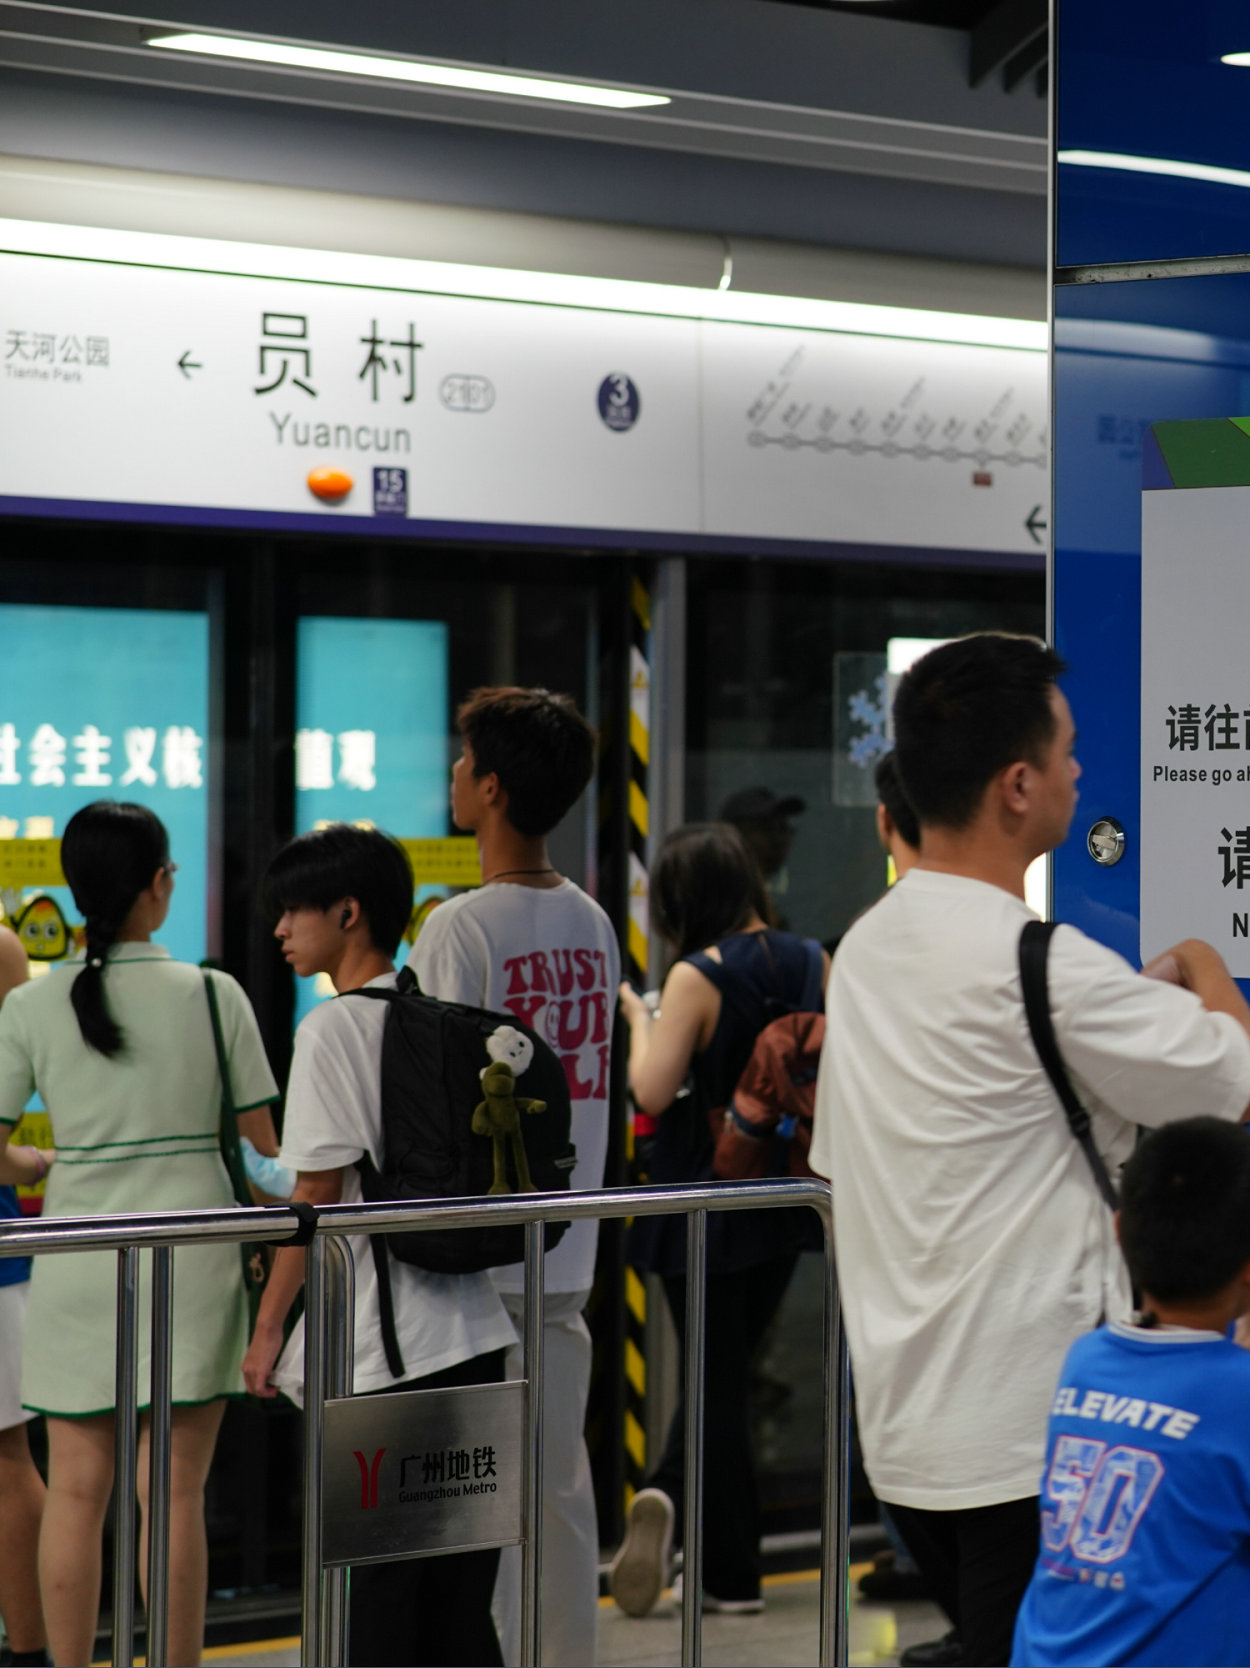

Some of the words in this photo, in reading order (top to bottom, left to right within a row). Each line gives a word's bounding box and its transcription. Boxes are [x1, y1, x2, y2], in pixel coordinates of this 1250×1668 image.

[5, 330, 110, 367] 天河公园
[253, 312, 424, 403] 员村
[609, 372, 631, 407] 3
[269, 411, 412, 454] Yuancun
[377, 469, 403, 494] 15
[1153, 765, 1207, 782] Please
[1211, 768, 1232, 786] go
[1052, 1387, 1200, 1440] ELEVATE
[400, 1446, 497, 1489] 广州地铁
[399, 1485, 461, 1504] Guangzhou
[463, 1481, 498, 1497] Metro
[1041, 1434, 1164, 1564] 50
